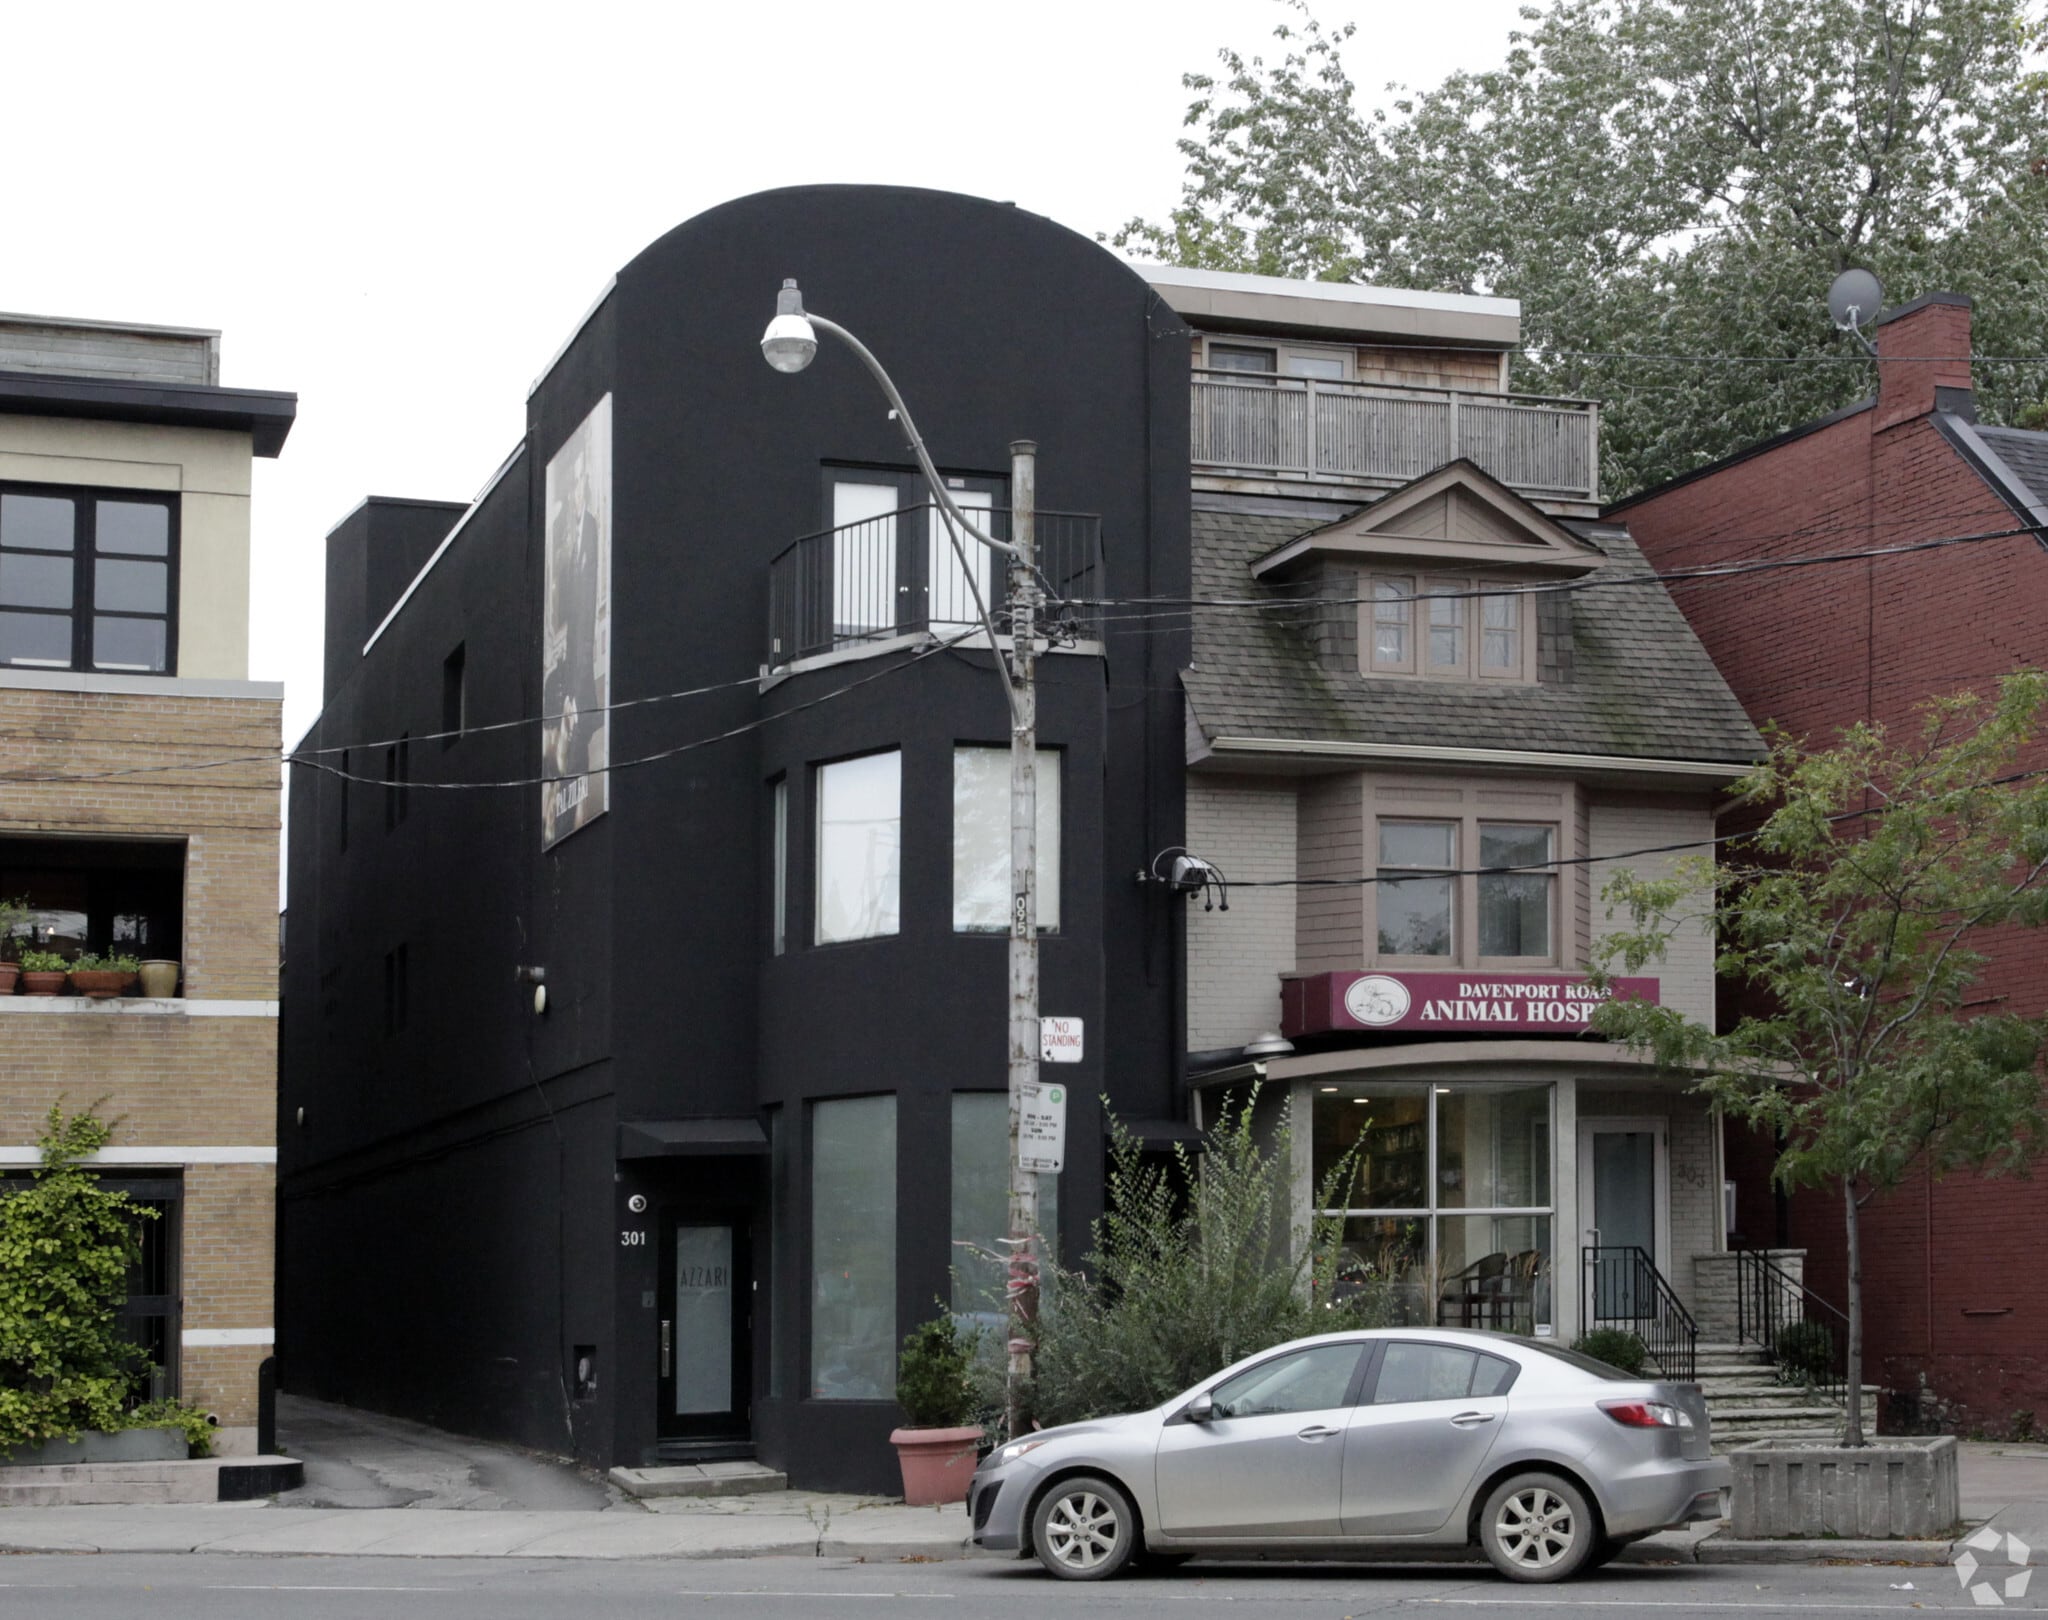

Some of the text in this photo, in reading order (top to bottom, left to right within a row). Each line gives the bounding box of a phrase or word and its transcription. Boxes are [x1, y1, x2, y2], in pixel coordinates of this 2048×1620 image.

[1016, 896, 1026, 935] 095
[1459, 983, 1560, 999] DAVENPORT
[1420, 1000, 1519, 1022] ANIMAL
[1055, 1021, 1069, 1034] NO
[1043, 1034, 1081, 1048] STANDING
[620, 1231, 646, 1246] 301
[680, 1266, 728, 1288] AZZARI
